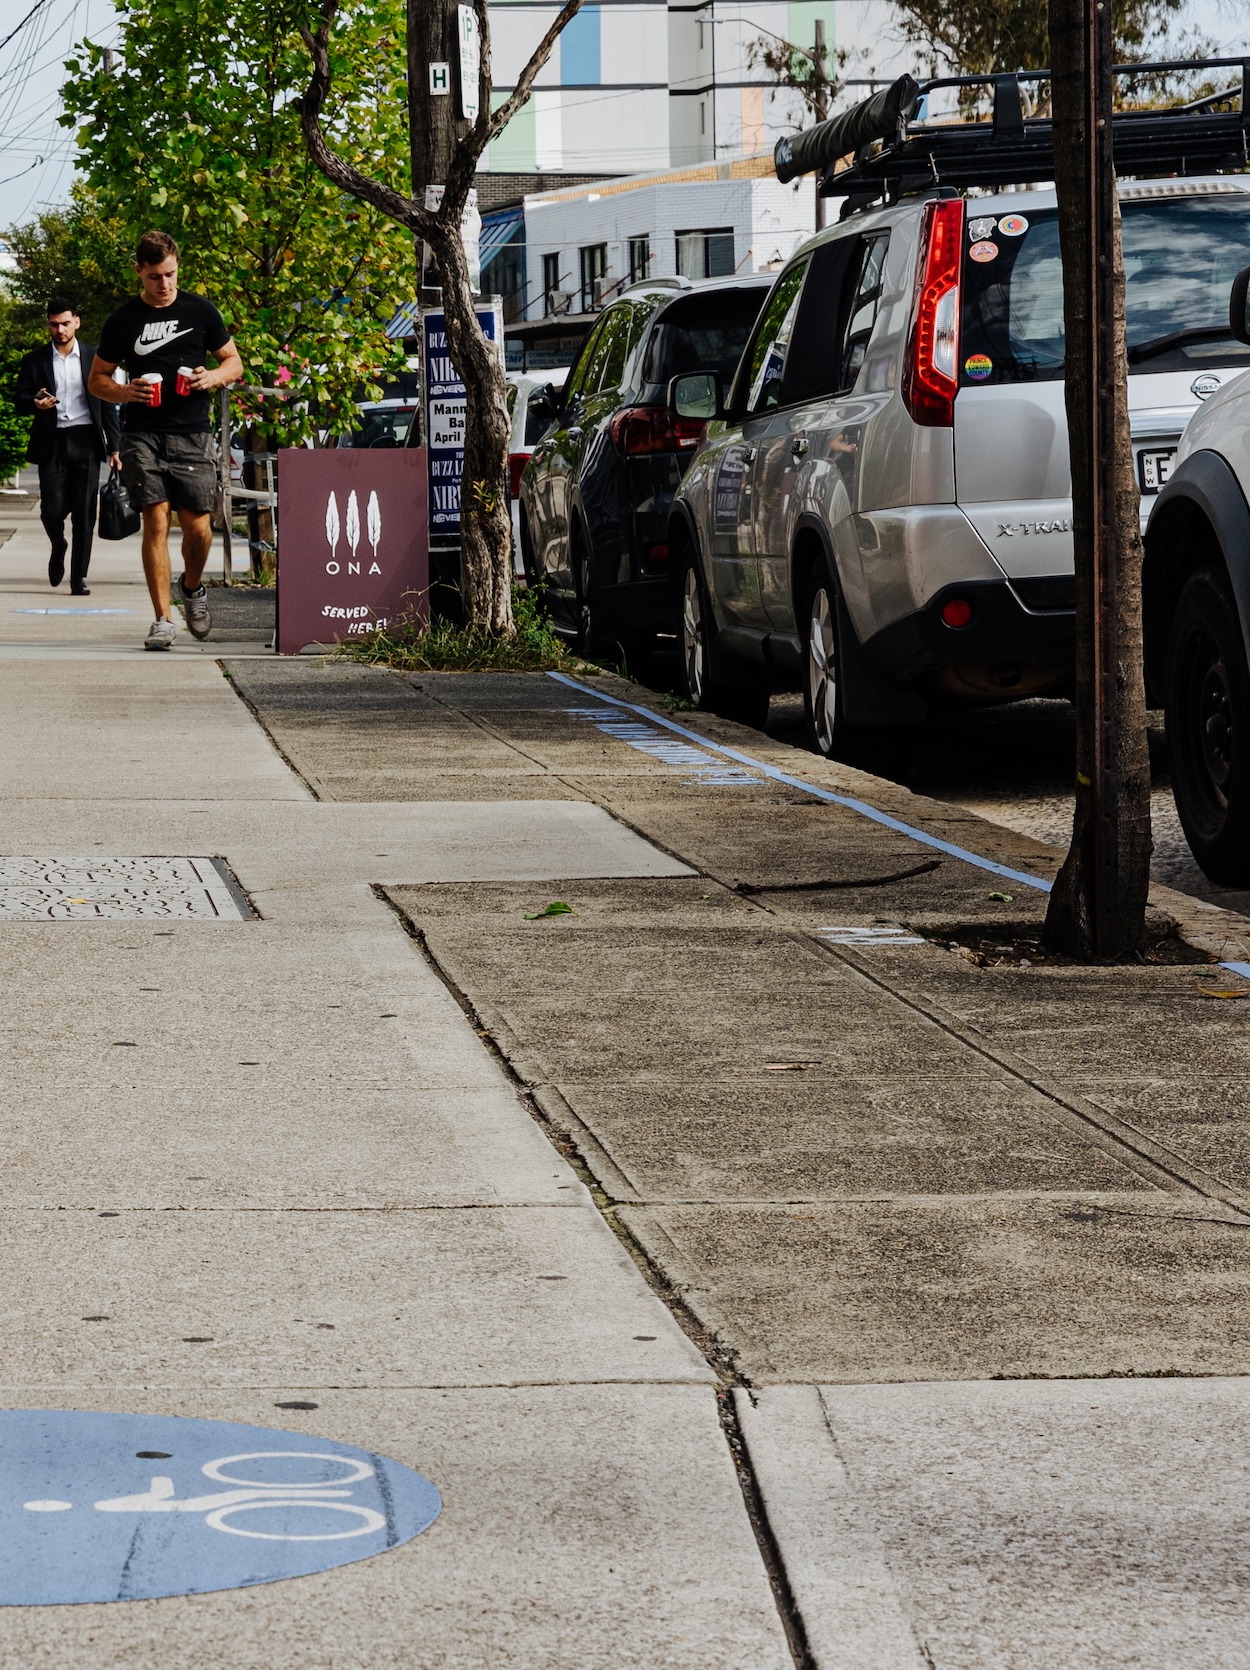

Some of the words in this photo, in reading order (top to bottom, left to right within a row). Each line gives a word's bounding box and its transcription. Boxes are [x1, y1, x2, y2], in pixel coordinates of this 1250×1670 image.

[432, 69, 446, 88] H
[141, 319, 179, 341] NIKE
[429, 332, 448, 349] BUZ
[434, 431, 461, 444] April
[325, 561, 382, 575] ONA
[321, 605, 369, 619] SERVED
